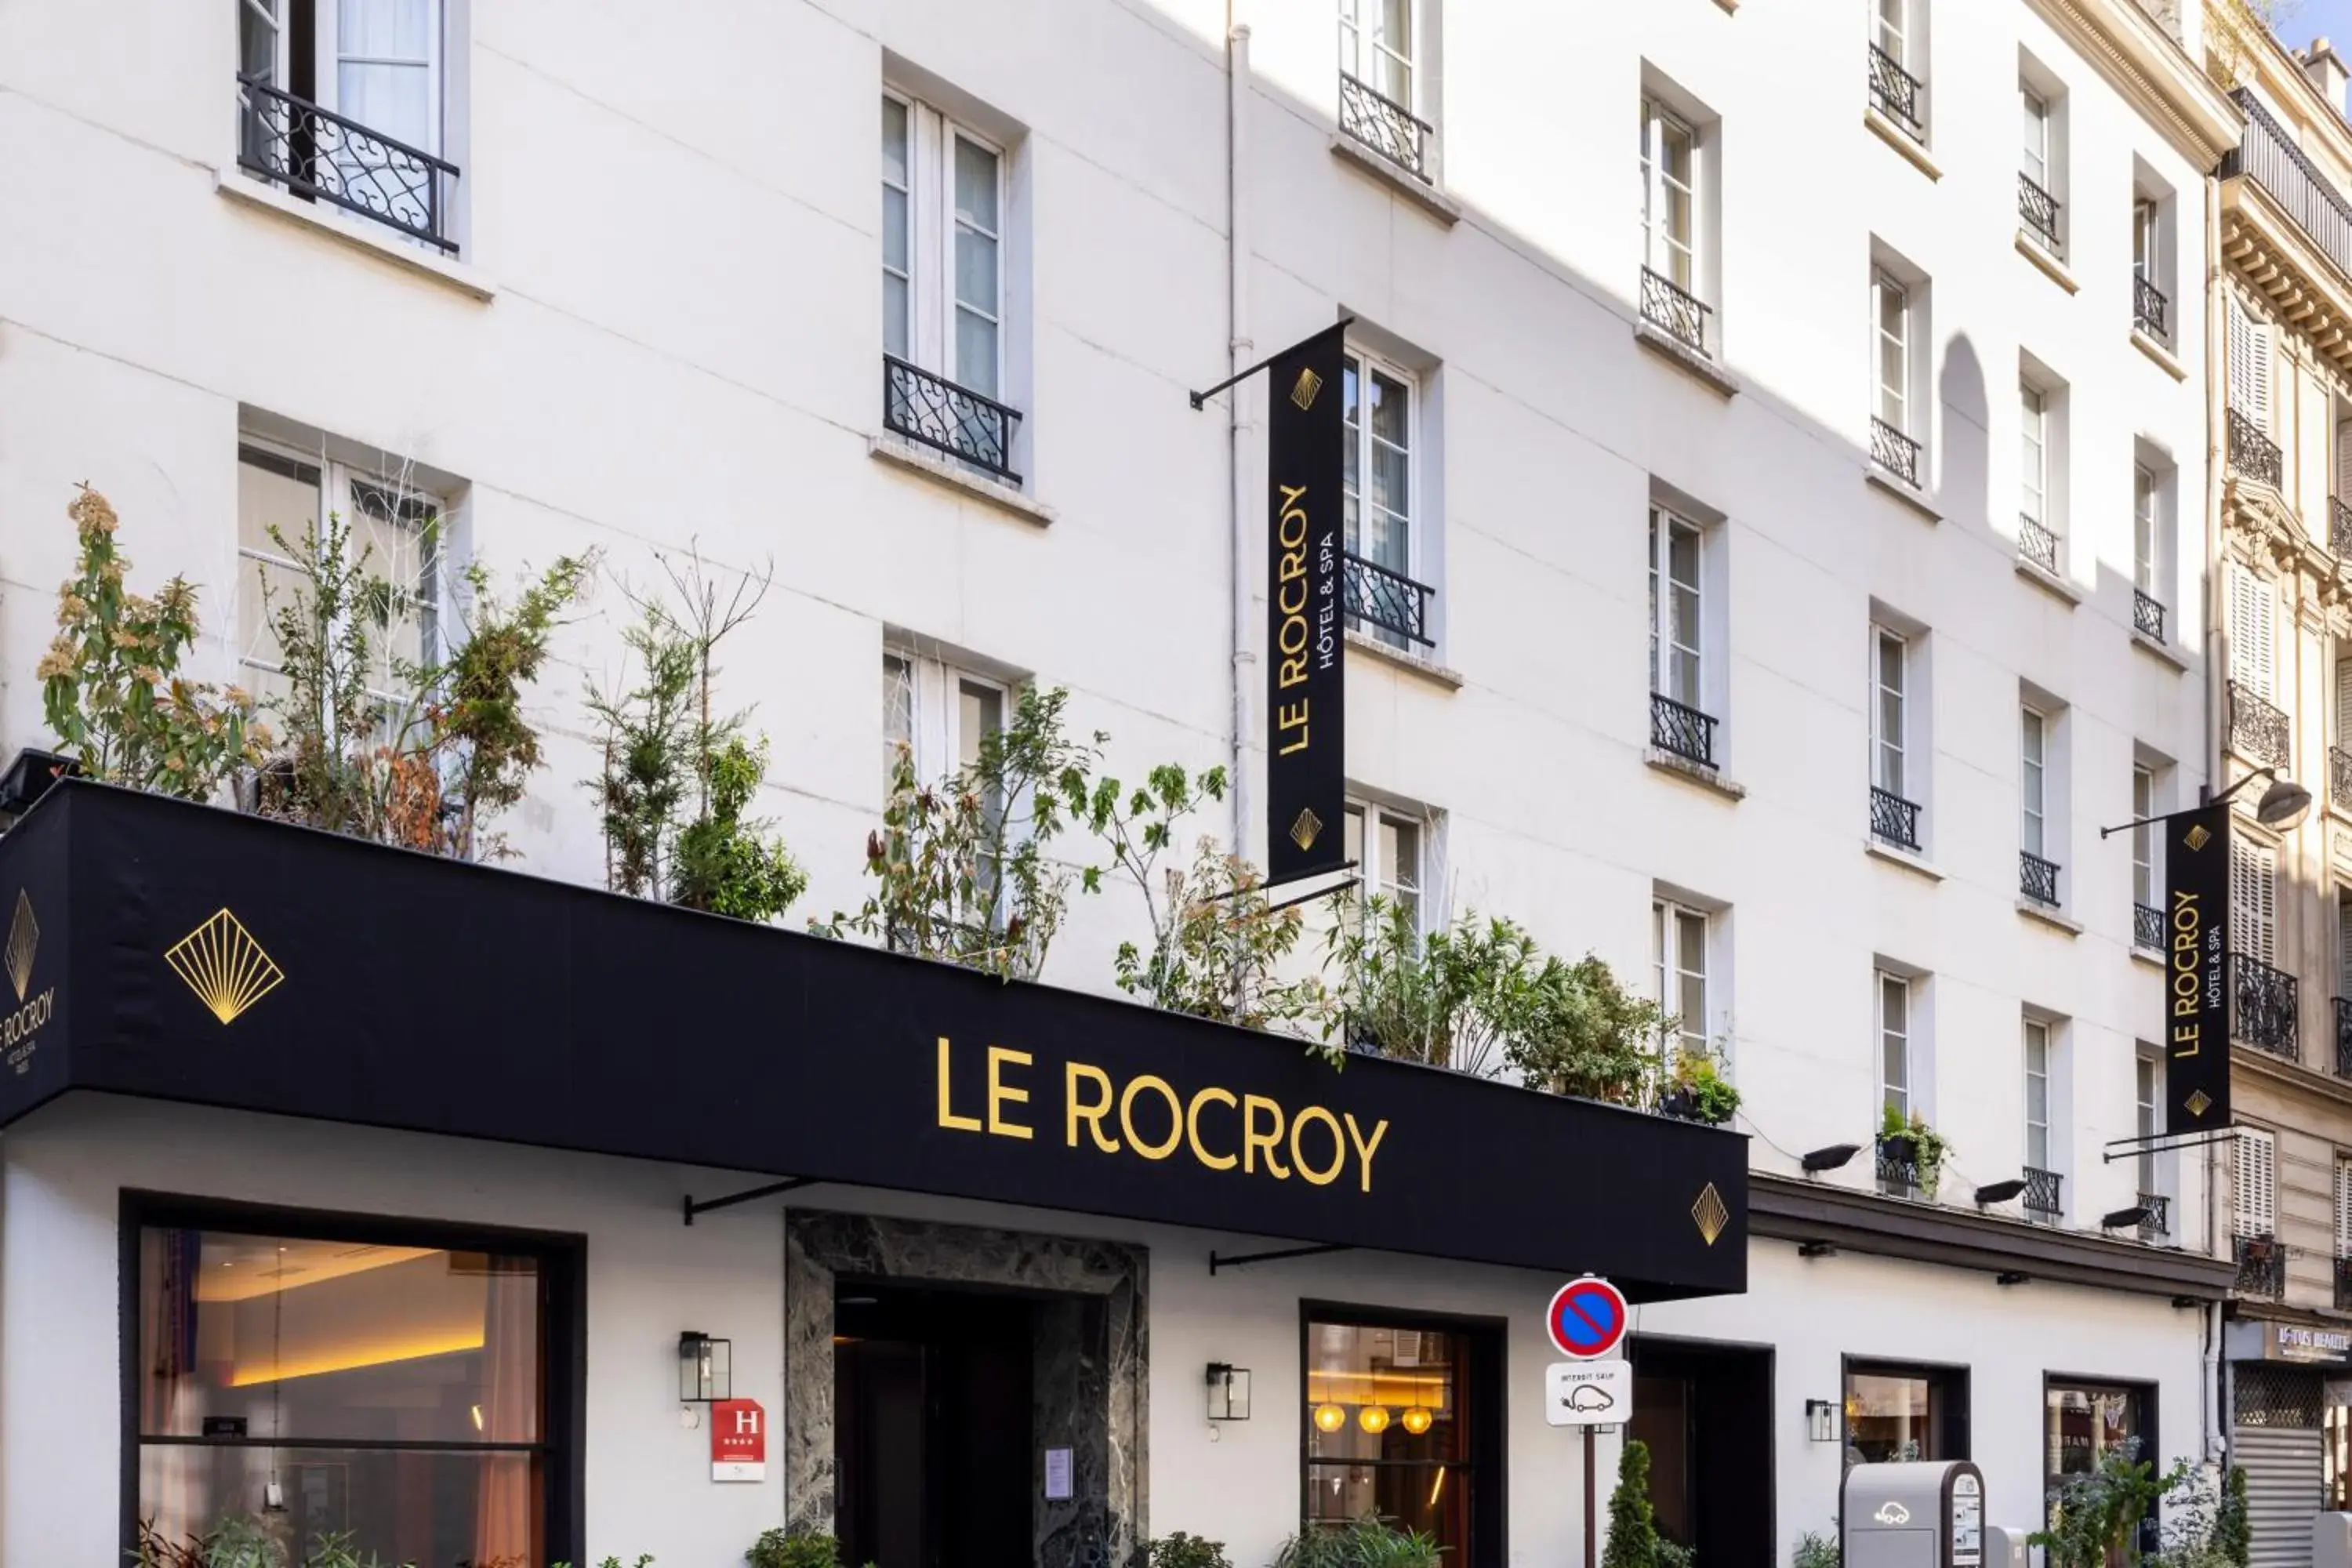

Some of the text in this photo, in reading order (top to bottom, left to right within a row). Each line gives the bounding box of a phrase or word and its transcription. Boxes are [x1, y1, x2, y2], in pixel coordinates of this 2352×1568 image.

[1279, 484, 1308, 756] LE ROCROY
[1317, 532, 1334, 670] HÔTEL & SPA
[4, 986, 55, 1048] ROCROY
[2174, 891, 2199, 1058] LE ROCROY
[2206, 925, 2221, 1009] HÔTEL & SPA
[938, 1036, 1389, 1192] LE ROCROY
[735, 1410, 760, 1434] H
